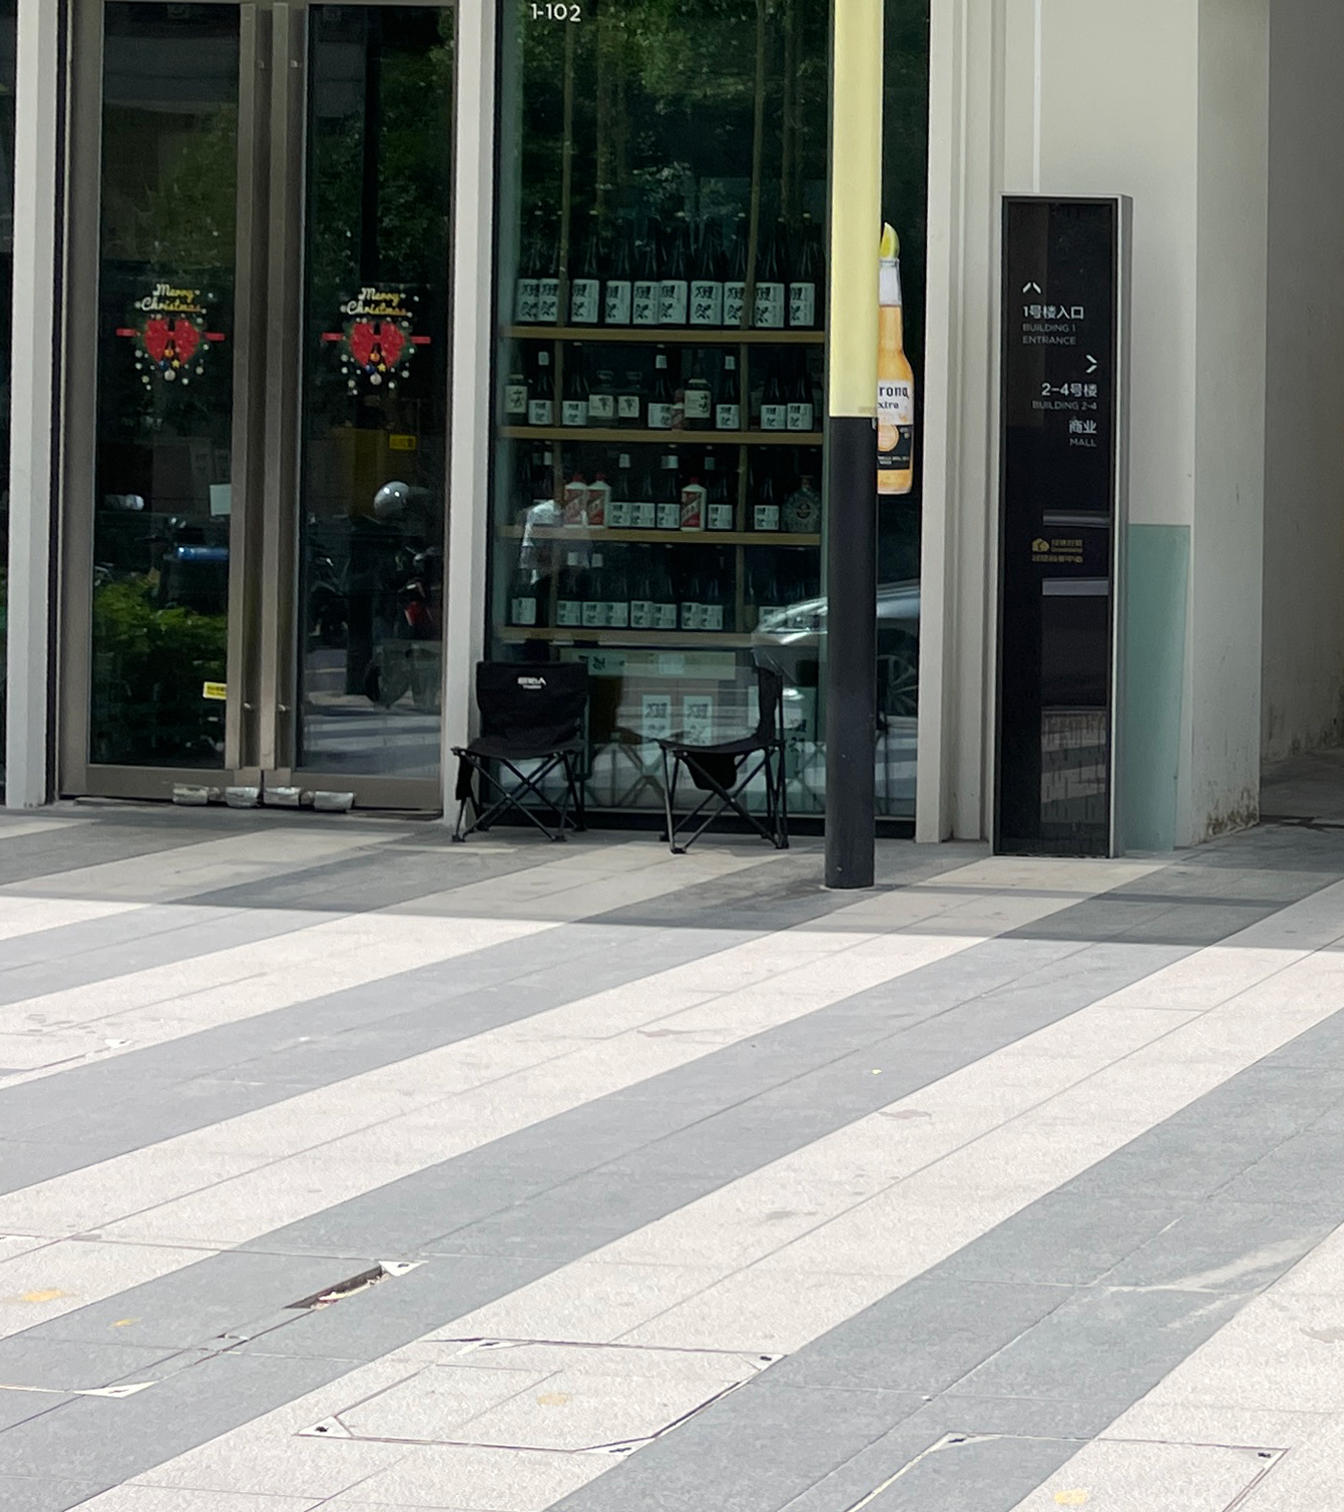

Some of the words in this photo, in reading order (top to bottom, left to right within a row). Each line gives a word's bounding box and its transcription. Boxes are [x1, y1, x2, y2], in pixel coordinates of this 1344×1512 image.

[530, 3, 581, 23] 1-102
[152, 284, 194, 303] Merry
[358, 287, 400, 306] Merry
[141, 296, 202, 312] Christmas
[346, 300, 407, 316] Christmas
[1023, 304, 1084, 319] 1号楼入口
[1022, 323, 1069, 333] BUILDING
[1022, 336, 1077, 345] ENTRANCE
[879, 386, 909, 400] rona
[1041, 382, 1098, 397] 2-4号楼
[878, 401, 899, 410] xtra
[1032, 400, 1079, 410] BUILDING
[1081, 401, 1098, 410] 2-4
[1069, 419, 1098, 435] 商业
[1069, 437, 1098, 448] MALL
